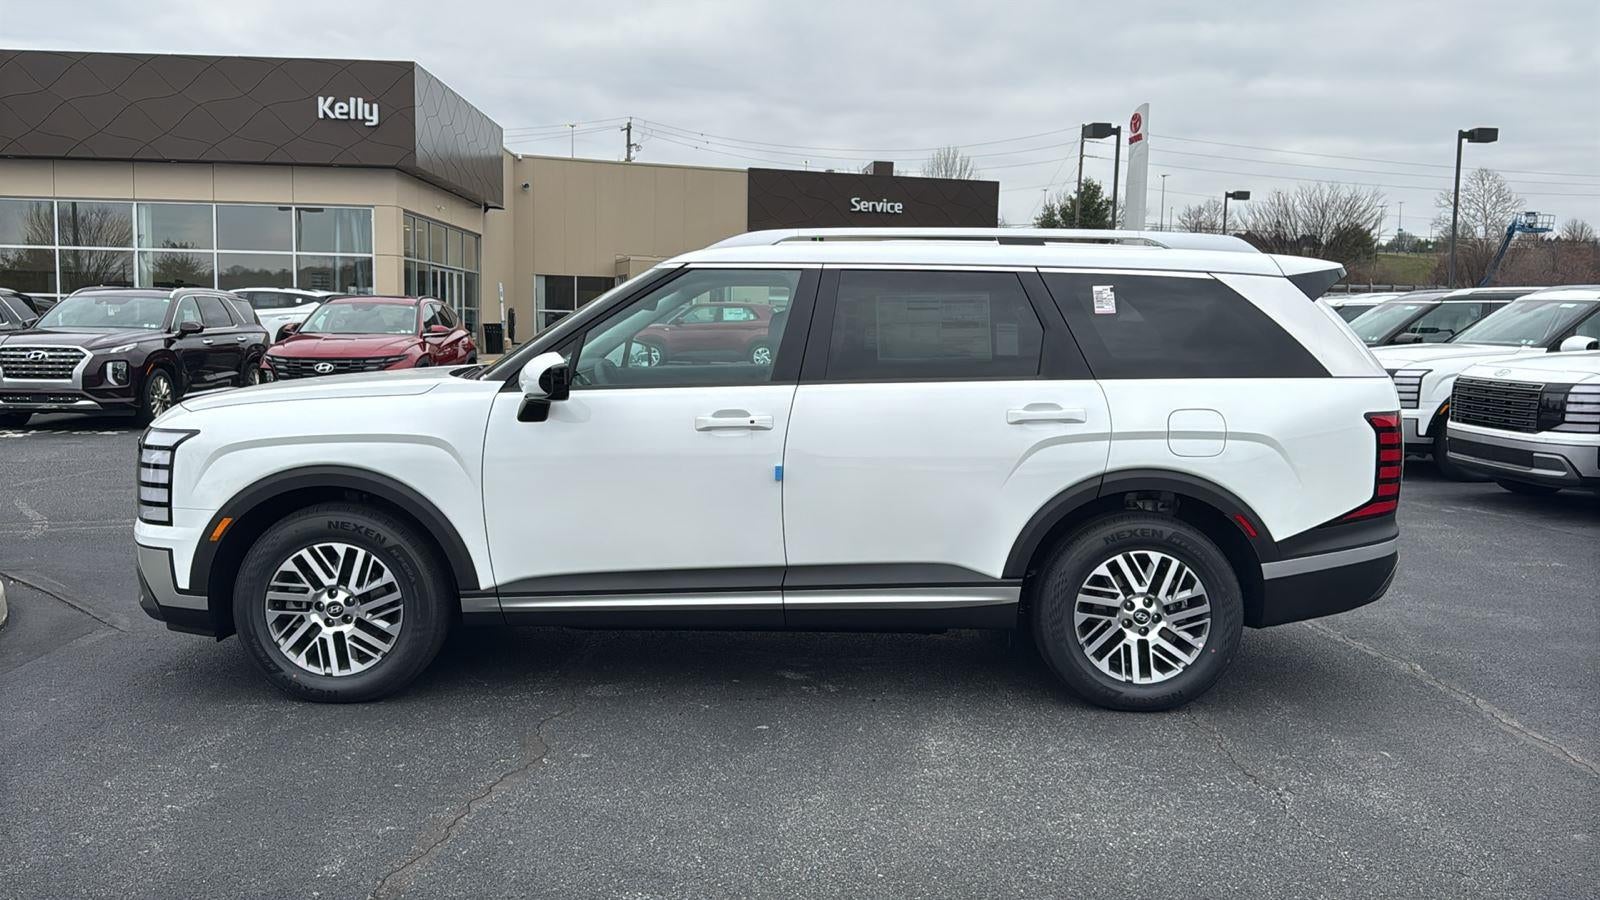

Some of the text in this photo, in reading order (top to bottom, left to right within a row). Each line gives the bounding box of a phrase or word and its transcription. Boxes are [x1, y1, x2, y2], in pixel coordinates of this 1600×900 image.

[317, 96, 379, 126] Kelly
[850, 197, 903, 214] Service
[327, 520, 388, 545] NEXEN
[1103, 527, 1164, 545] NEXEN
